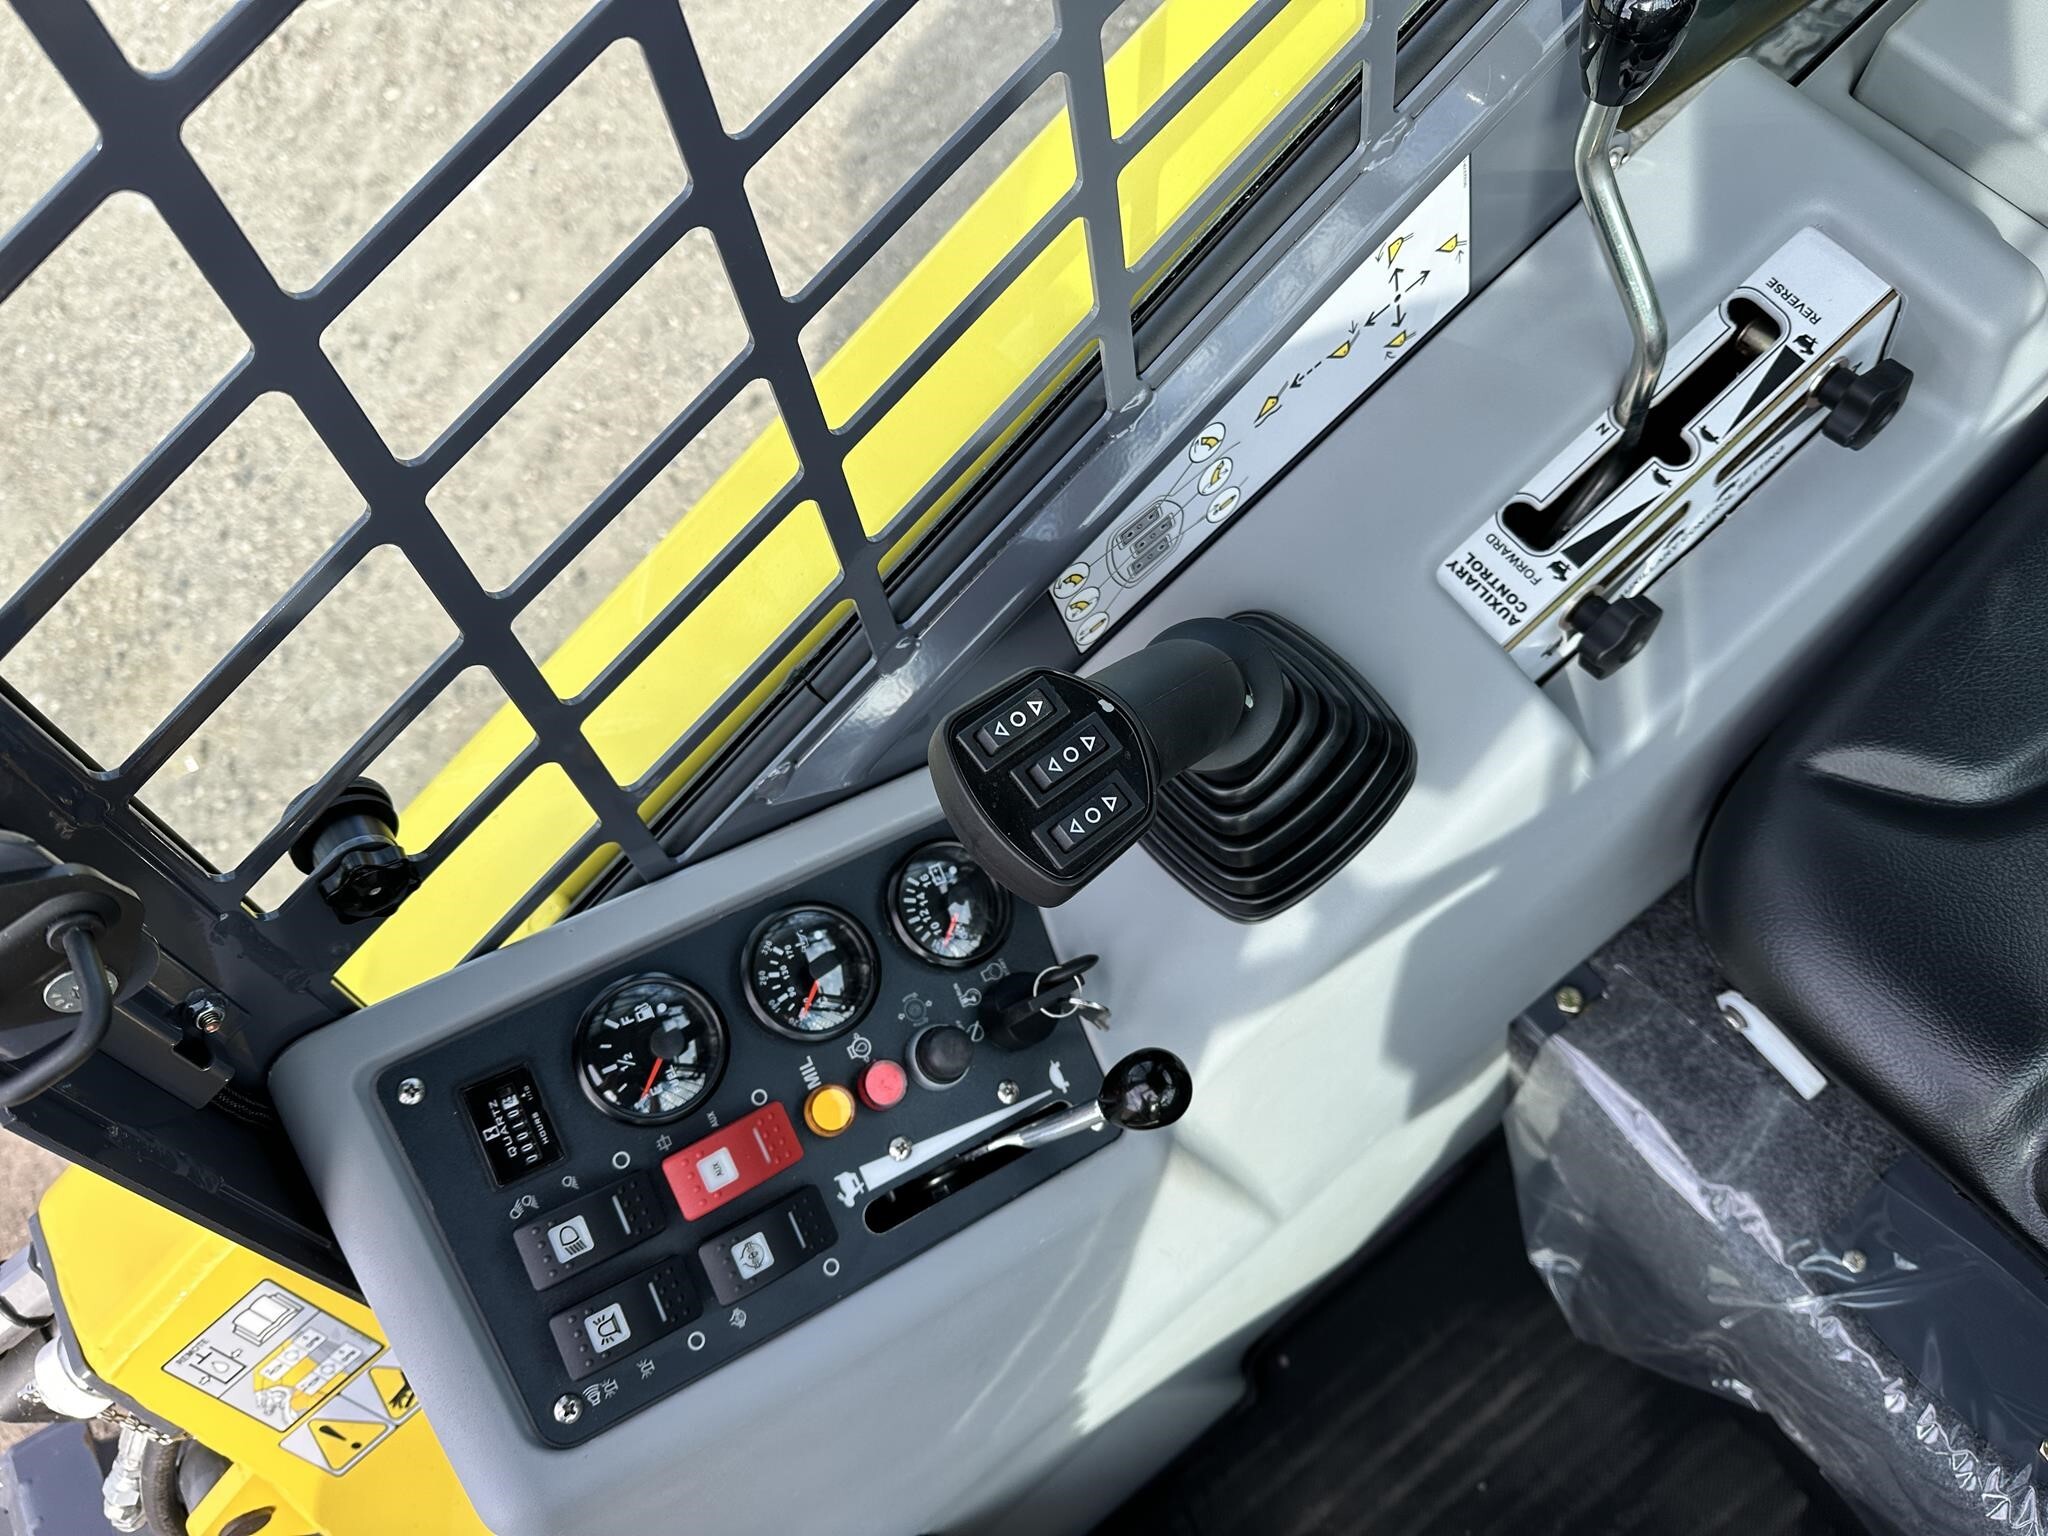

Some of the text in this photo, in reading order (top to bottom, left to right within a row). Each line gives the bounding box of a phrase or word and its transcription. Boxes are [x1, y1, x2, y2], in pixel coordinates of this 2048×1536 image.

[1765, 276, 1822, 325] REVERSE
[1595, 422, 1611, 436] N
[1485, 533, 1543, 586] FORWARD
[1467, 551, 1528, 613] CONTROL
[1445, 560, 1522, 626] AUXILIARY
[919, 873, 932, 888] 16
[916, 892, 929, 907] 14
[919, 908, 932, 923] 12
[930, 921, 943, 936] 10
[784, 944, 795, 960] 170
[780, 964, 791, 980] 130
[787, 986, 797, 998] 90
[619, 1015, 635, 1027] F
[665, 1064, 681, 1094] FUEL
[799, 1055, 822, 1091] MIL
[650, 1083, 663, 1097] E
[706, 1110, 719, 1128] AUX
[488, 1099, 518, 1158] QUARTZ
[531, 1111, 550, 1145] HOURS
[712, 1160, 725, 1177] AUX
[175, 1338, 209, 1365] REMOTE
